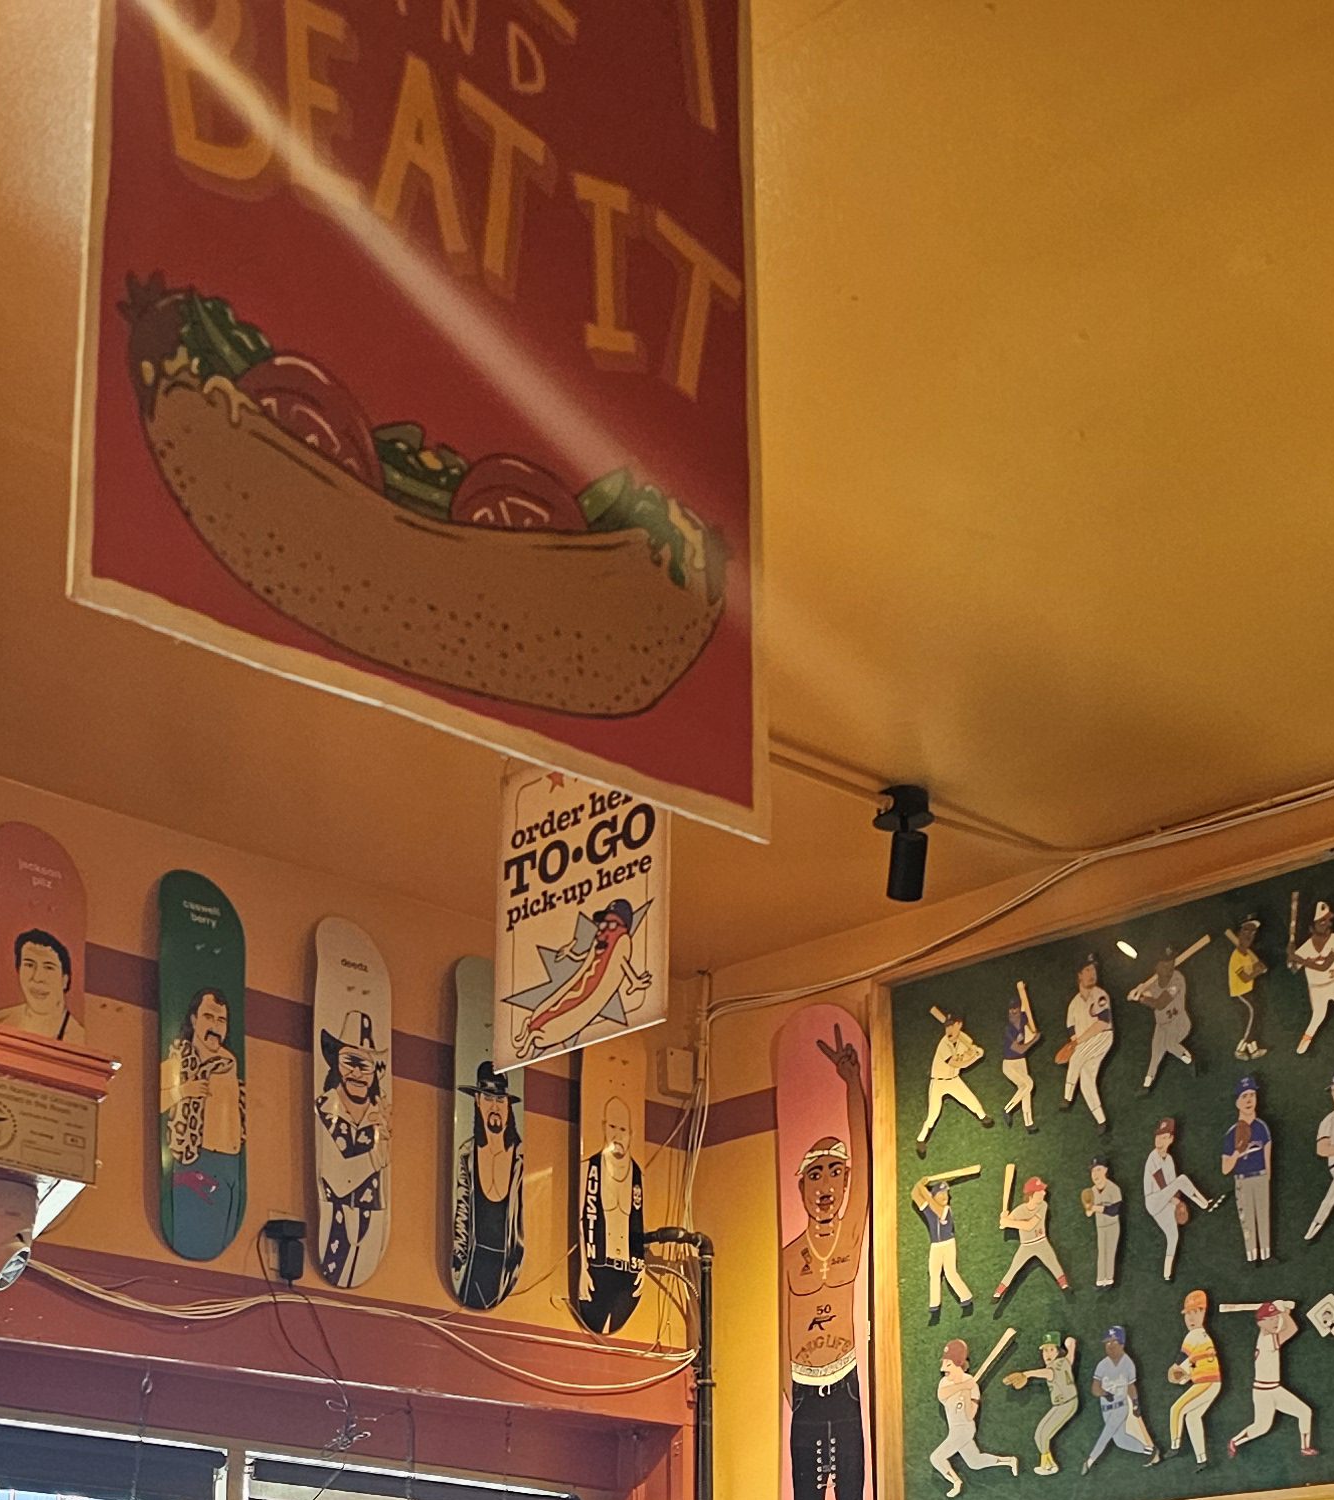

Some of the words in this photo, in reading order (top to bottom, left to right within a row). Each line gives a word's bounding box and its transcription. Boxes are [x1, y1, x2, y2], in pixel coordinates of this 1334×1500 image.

[158, 0, 551, 285] BEAT
[573, 171, 743, 400] IT
[510, 803, 585, 850] order
[506, 877, 593, 932] pick-up
[596, 854, 653, 892] here
[586, 1164, 600, 1260] AUSTIN
[816, 1303, 832, 1315] 50
